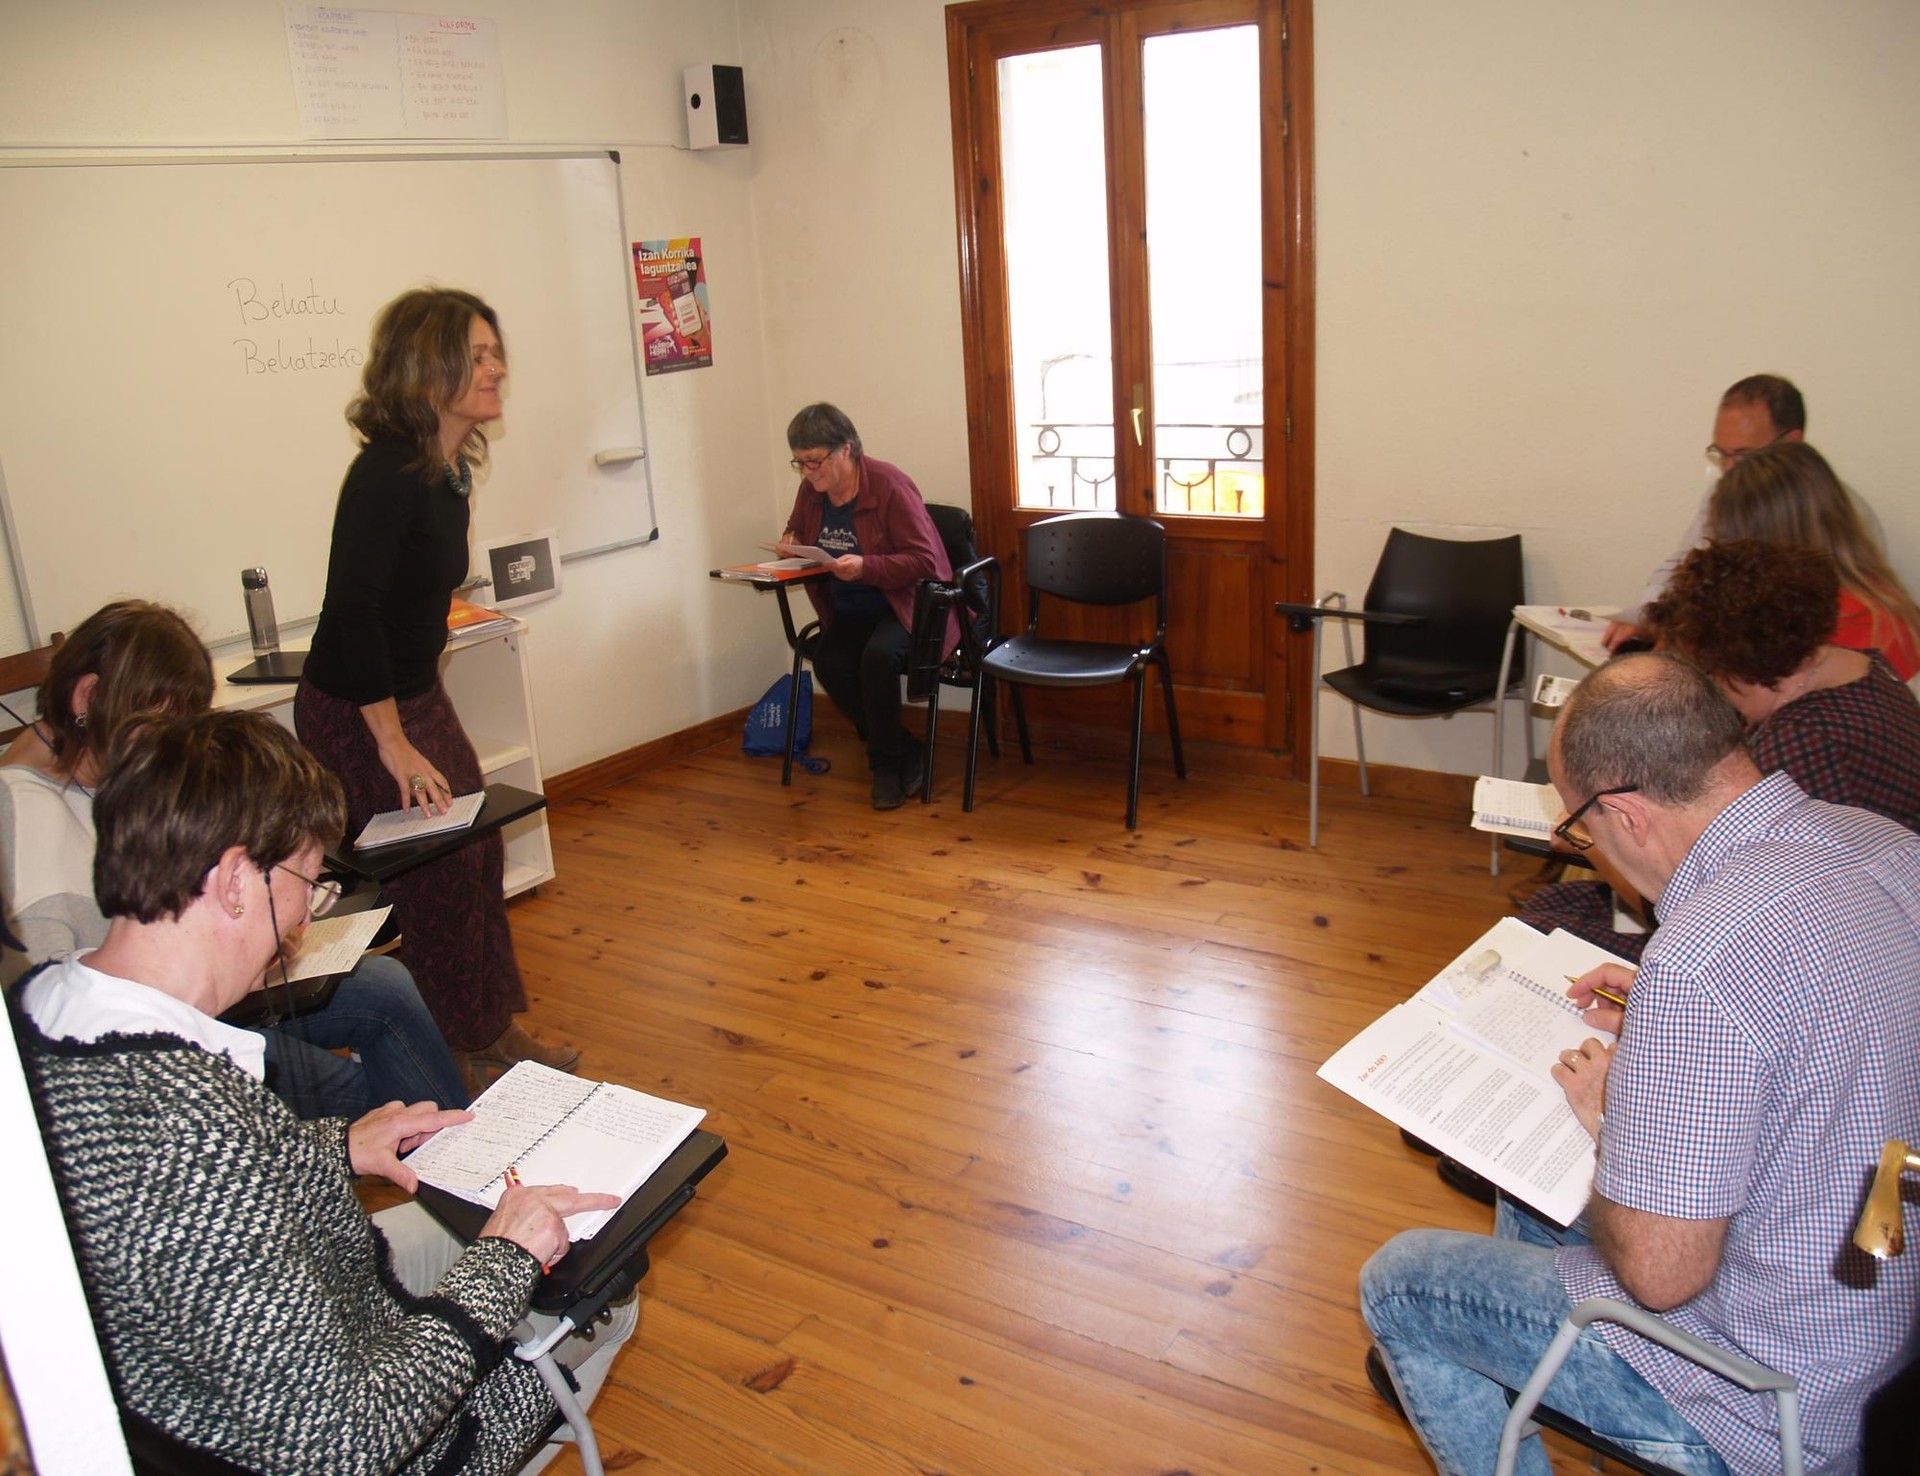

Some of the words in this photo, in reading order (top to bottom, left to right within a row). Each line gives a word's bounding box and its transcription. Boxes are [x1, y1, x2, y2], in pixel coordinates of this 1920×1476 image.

[638, 250, 660, 262] Izan
[661, 247, 695, 260] Korrika
[640, 259, 698, 277] laguntzailea
